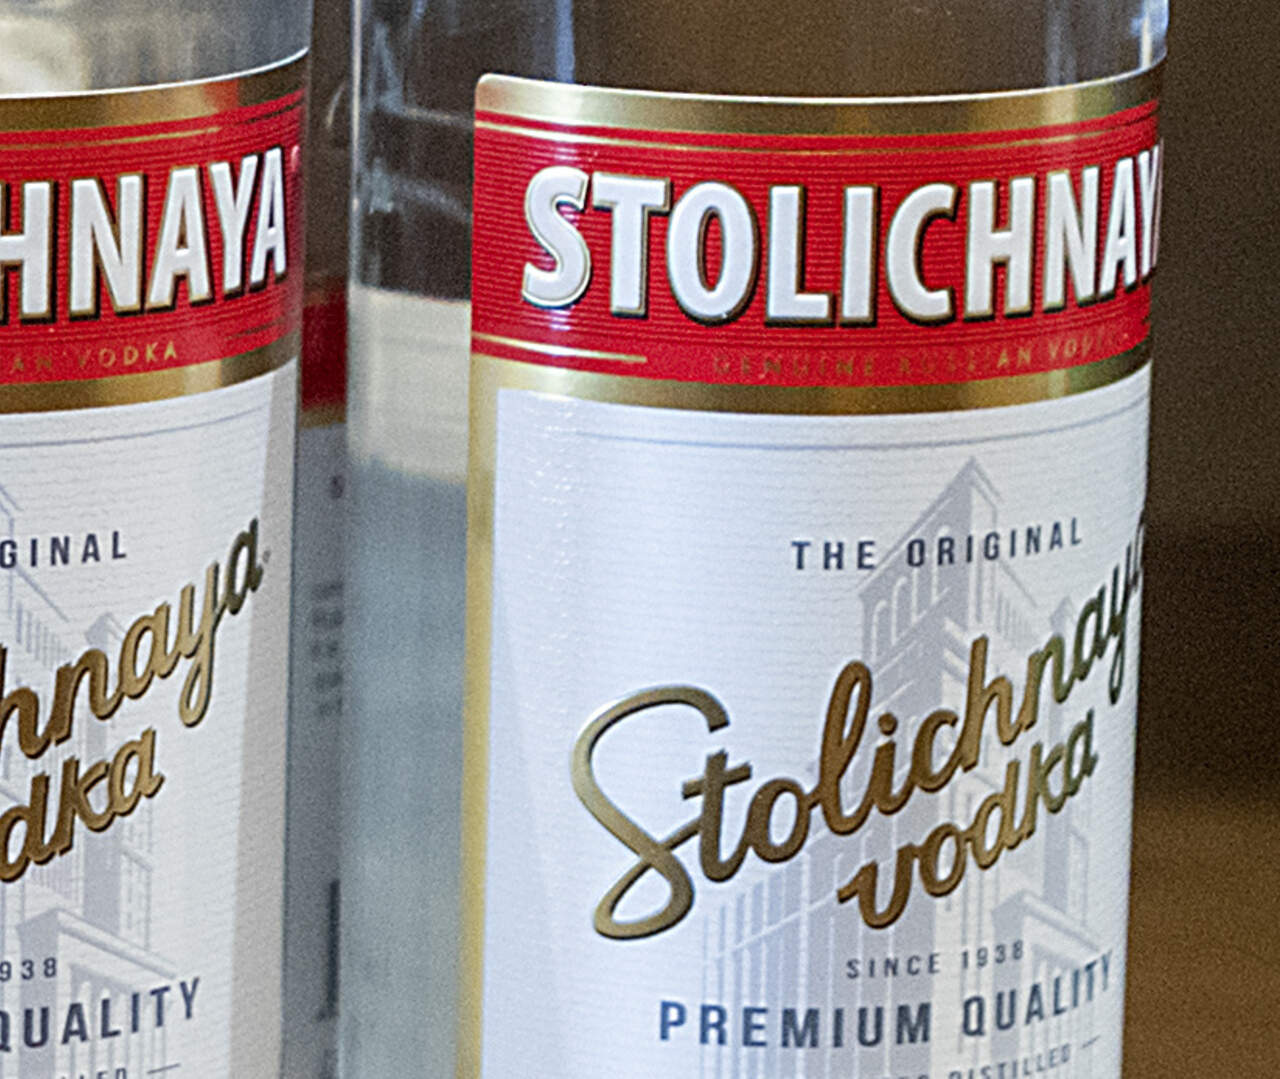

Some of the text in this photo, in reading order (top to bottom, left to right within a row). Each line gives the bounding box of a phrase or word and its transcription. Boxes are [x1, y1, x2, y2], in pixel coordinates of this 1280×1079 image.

[74, 339, 179, 369] VODKA
[791, 516, 1084, 572] THE ORIGINAL
[836, 708, 1101, 931] vodka
[845, 938, 1028, 981] SINCE 1938
[659, 951, 1114, 1051] PREMIUM QUALITY
